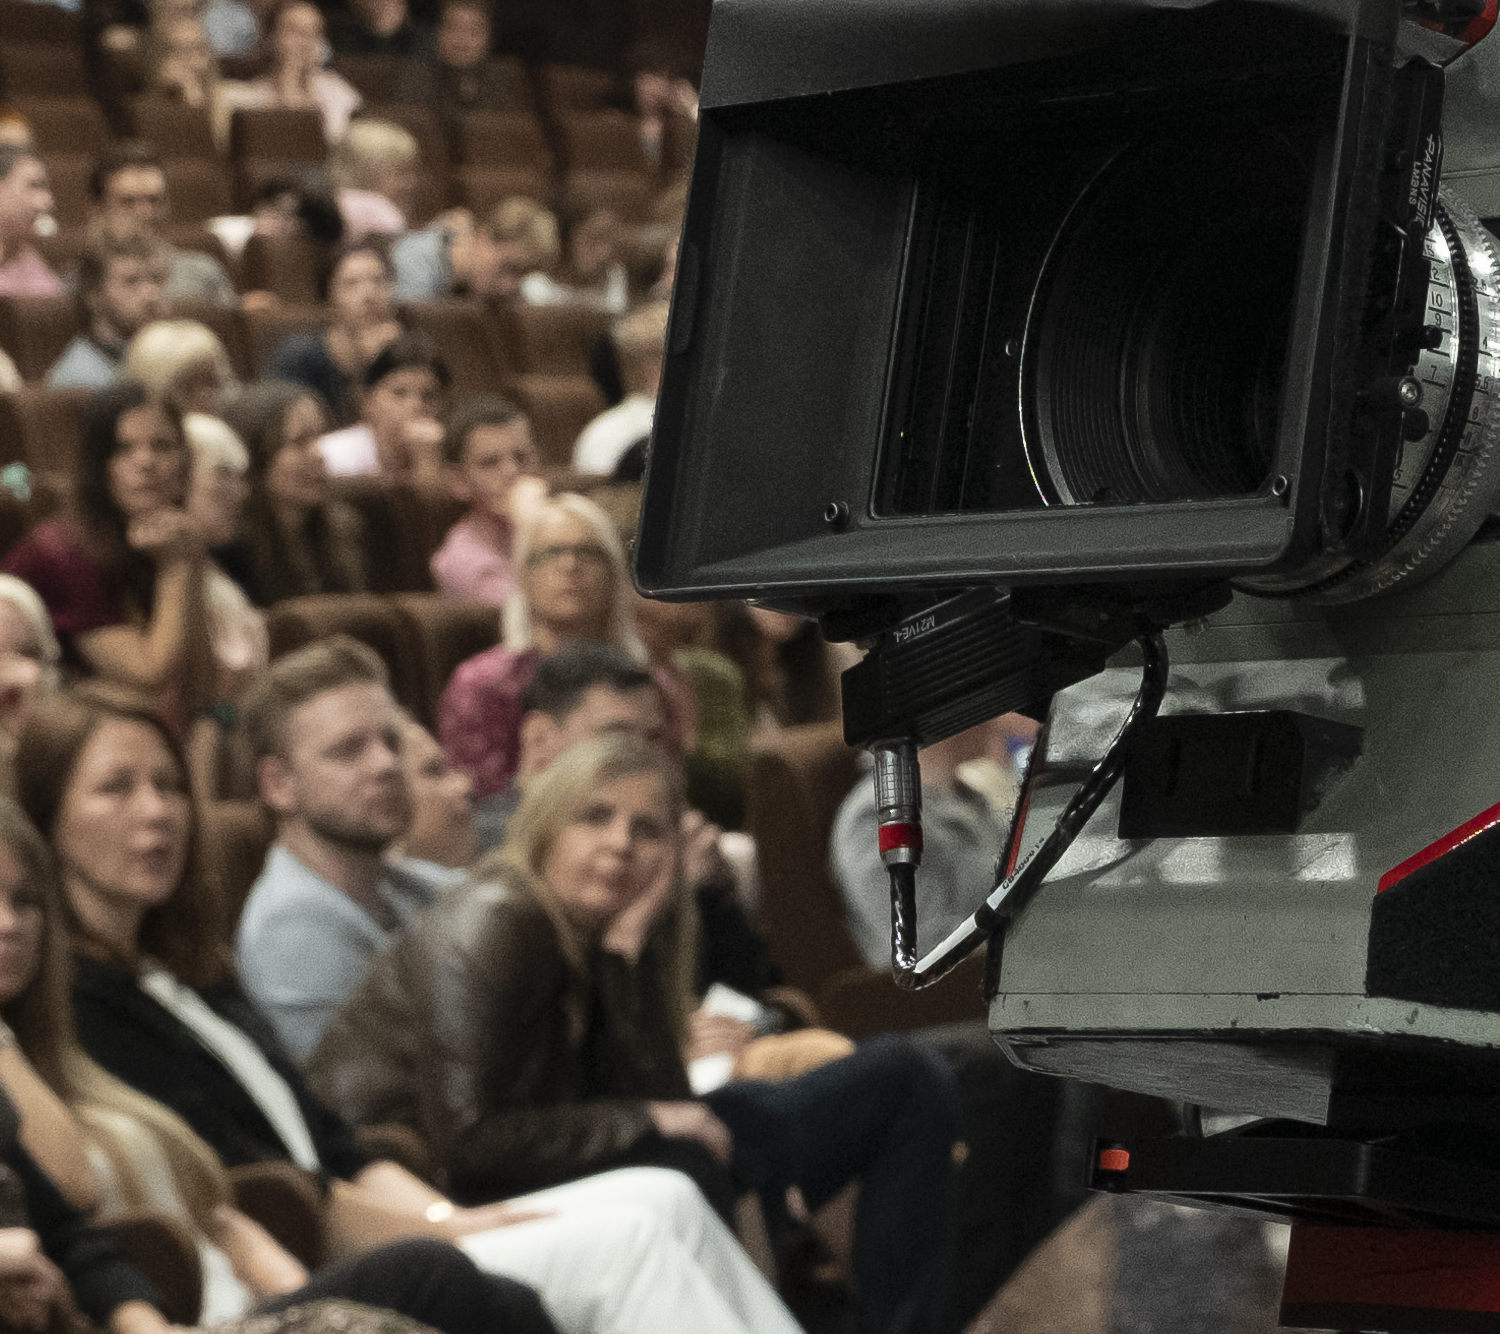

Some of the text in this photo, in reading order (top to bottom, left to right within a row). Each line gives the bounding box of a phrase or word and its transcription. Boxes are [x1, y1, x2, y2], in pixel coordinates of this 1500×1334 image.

[1415, 132, 1436, 228] PANAVISI
[1430, 291, 1443, 307] 10
[1429, 365, 1437, 380] 7
